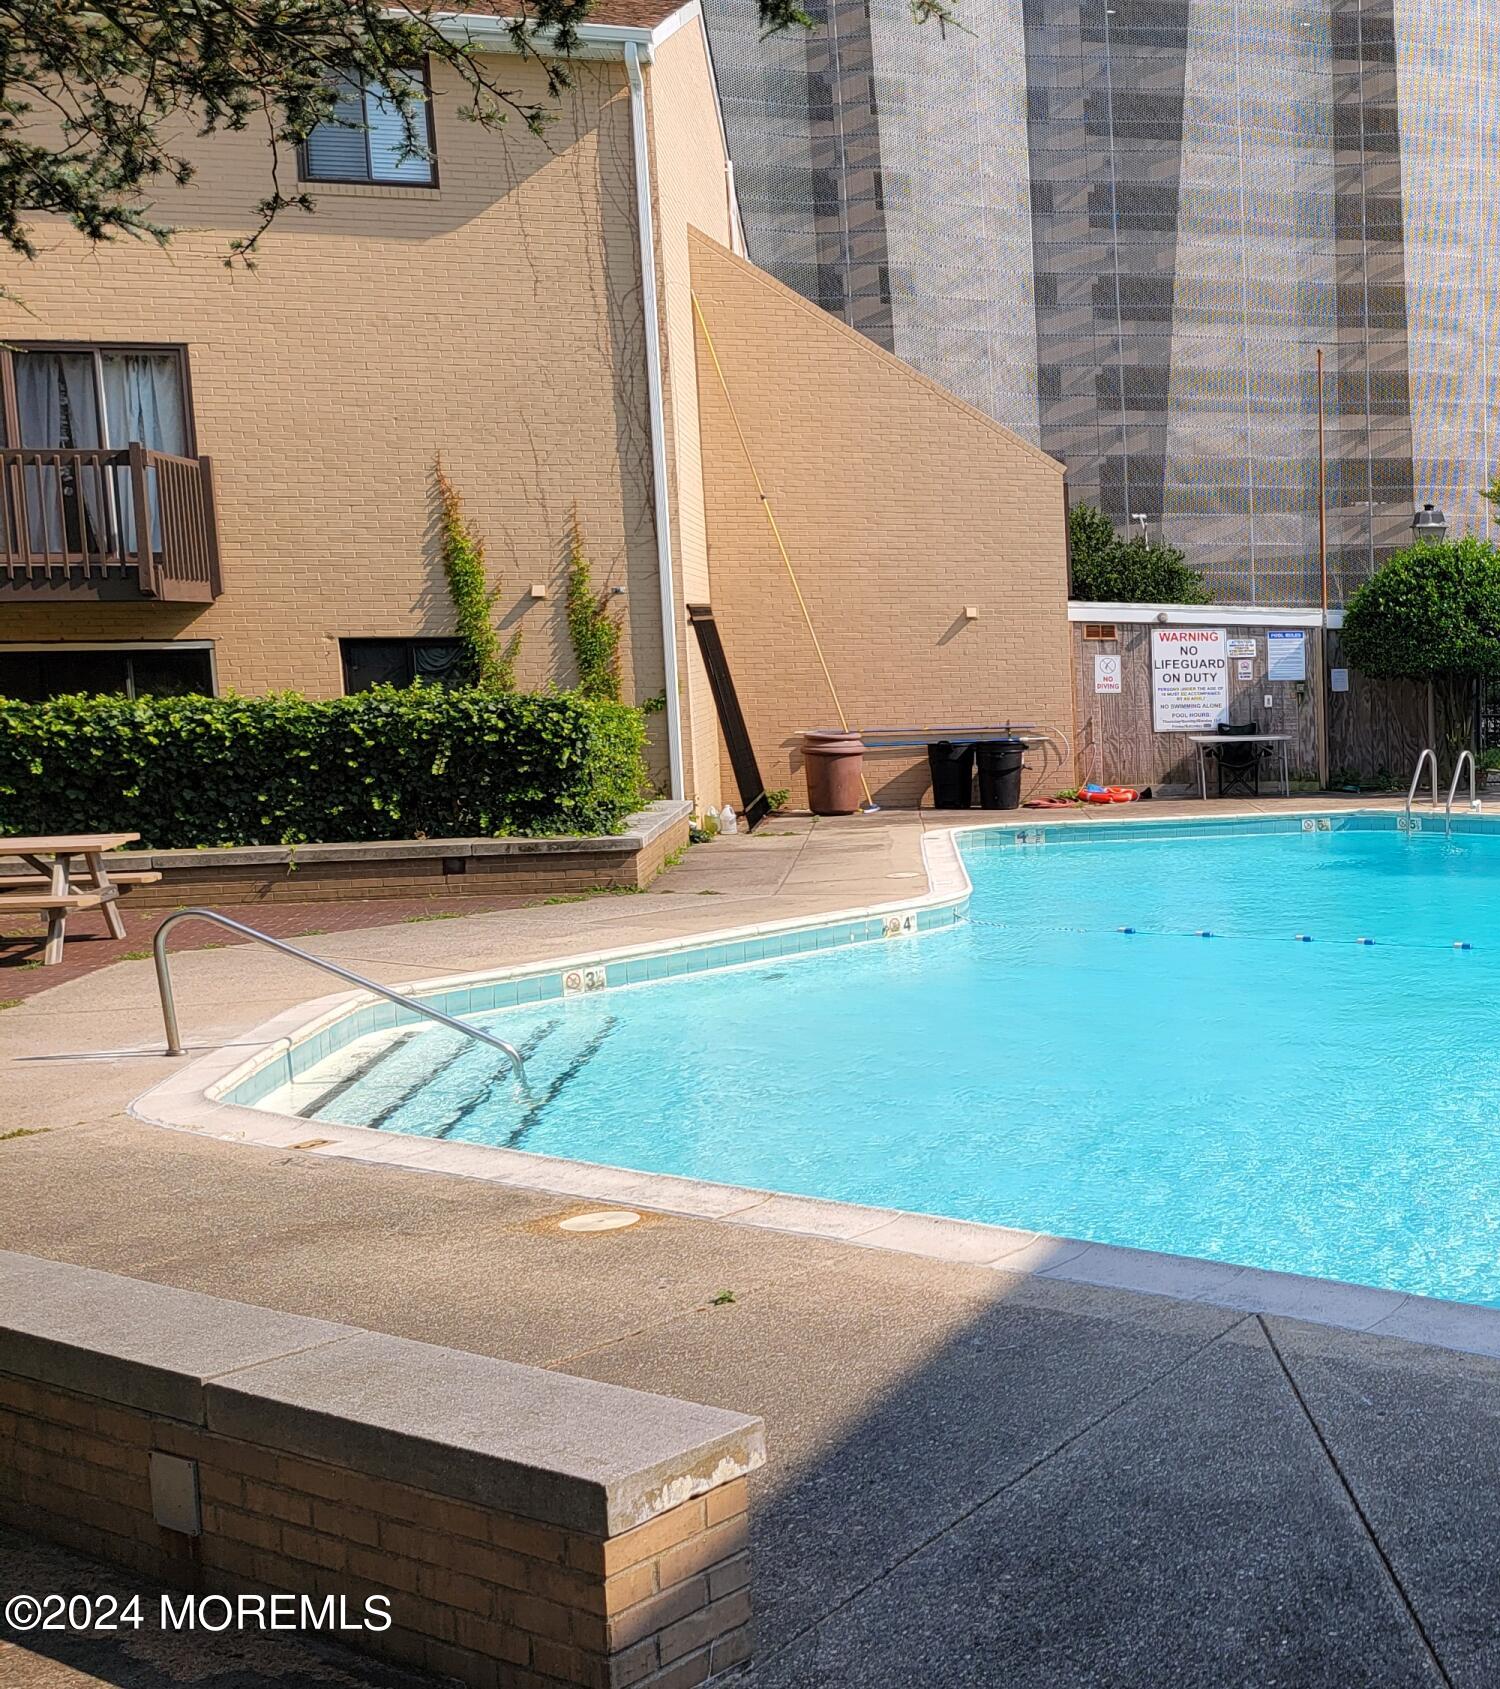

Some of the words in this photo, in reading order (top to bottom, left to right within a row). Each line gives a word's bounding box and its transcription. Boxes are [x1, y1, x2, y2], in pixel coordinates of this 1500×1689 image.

[1159, 632, 1219, 642] WARNING
[1180, 646, 1198, 655] NO
[1154, 659, 1225, 669] LIFEGUARD
[1162, 673, 1180, 683] ON
[1185, 672, 1217, 683] DUTY
